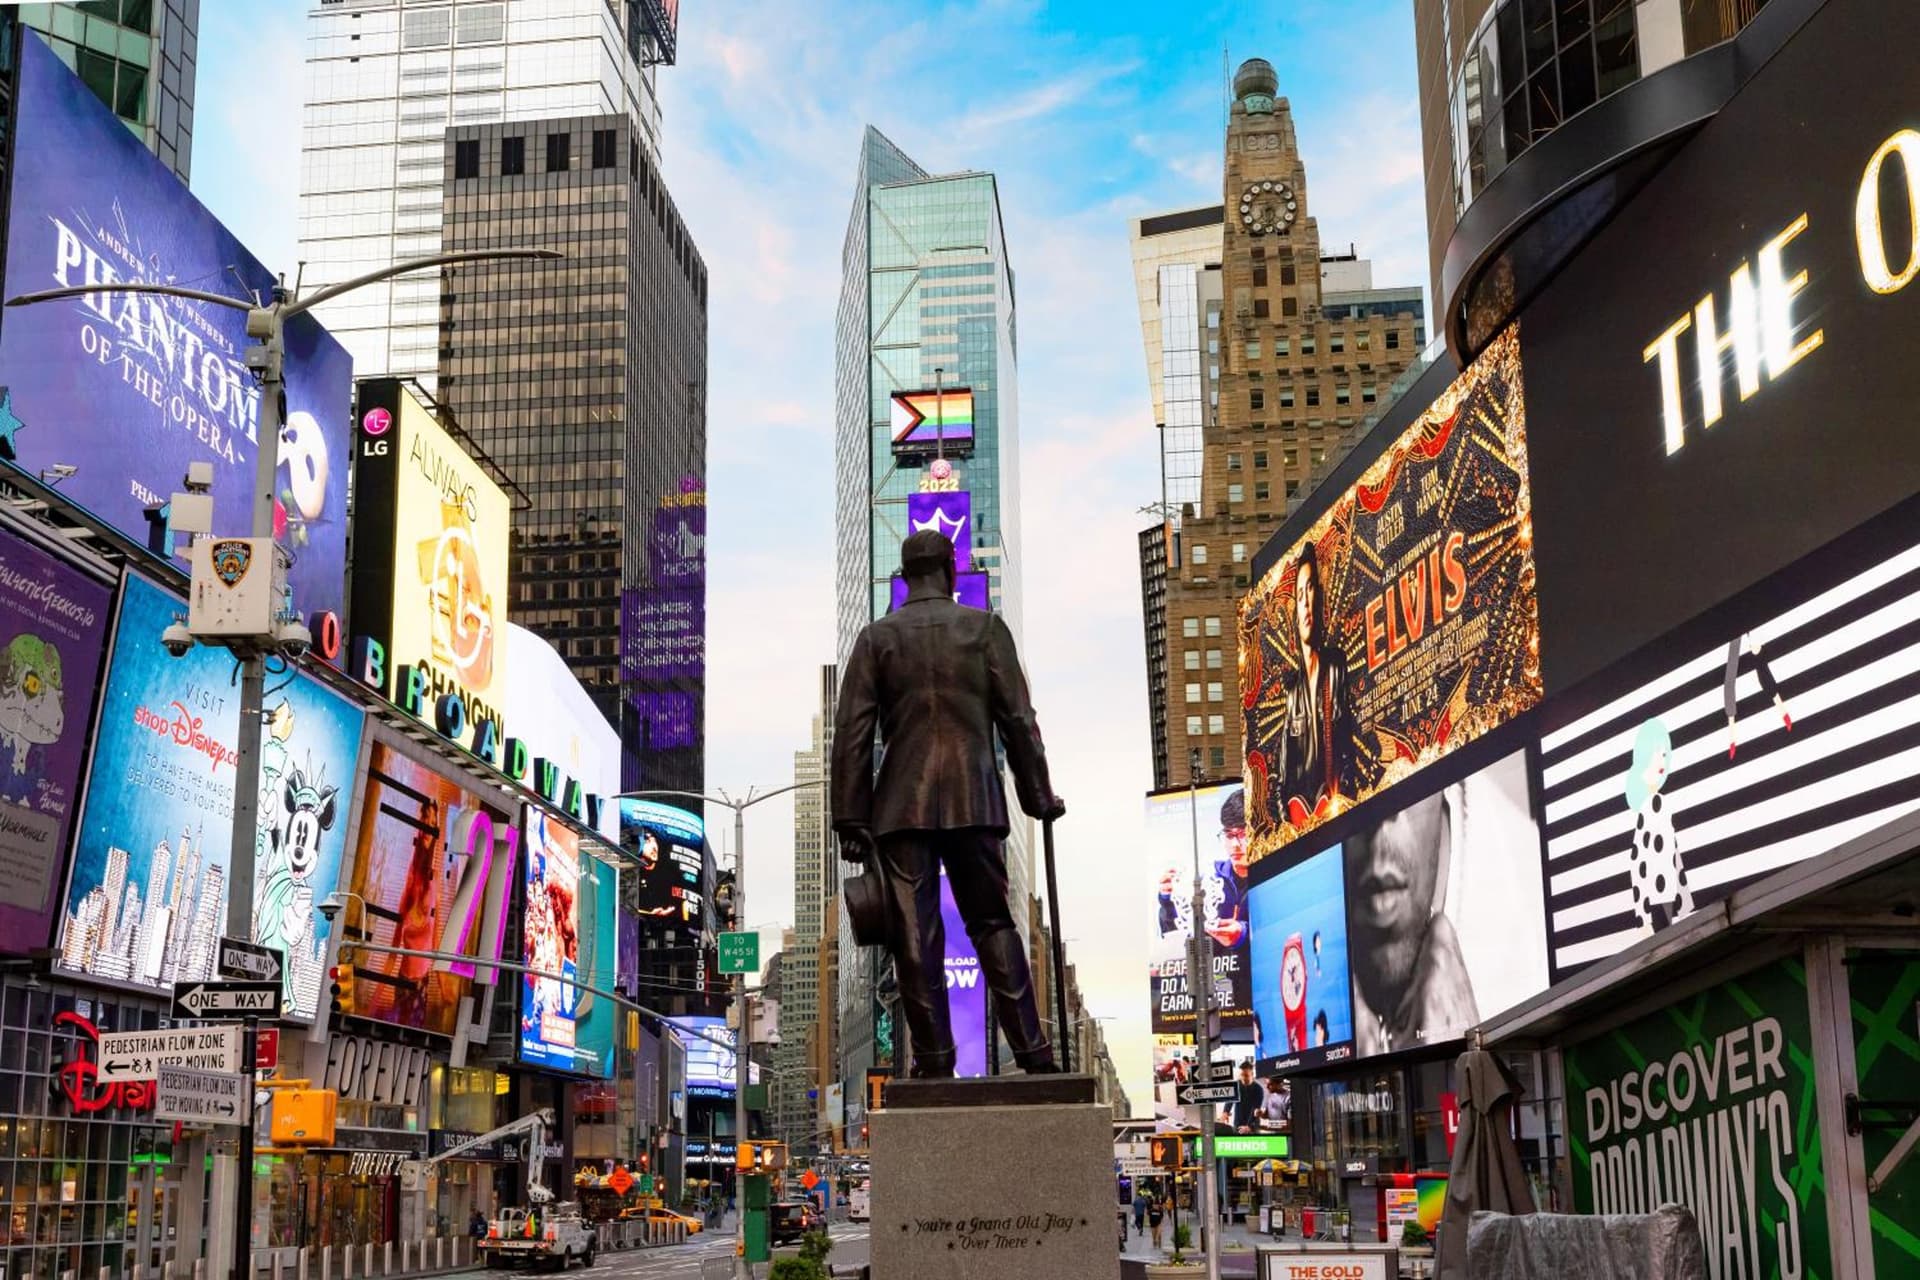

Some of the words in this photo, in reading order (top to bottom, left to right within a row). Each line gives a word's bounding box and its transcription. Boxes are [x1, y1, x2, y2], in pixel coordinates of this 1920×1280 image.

[98, 227, 146, 273] ANDREW
[49, 216, 259, 447] PHANTOM
[186, 305, 234, 354] WEBBER'S
[1643, 212, 1824, 457] THE
[81, 324, 112, 364] OF
[121, 352, 163, 407] THE
[364, 440, 388, 457] LG
[410, 432, 478, 523] ALWAYS
[919, 478, 960, 492] 2022
[1377, 501, 1403, 535] AUSTIN
[1376, 515, 1405, 553] BUTLER
[1366, 531, 1467, 673] ELVIS
[186, 682, 225, 716] VISIT
[416, 659, 504, 747] CHANGIN
[1401, 694, 1424, 723] JUNE
[1426, 683, 1438, 707] 24
[355, 635, 605, 833] BROADWAY
[127, 766, 177, 796] DELIVERED
[180, 786, 191, 802] TO
[193, 795, 215, 814] YOUR
[145, 753, 158, 769] TO
[161, 760, 184, 781] HAVE
[187, 770, 203, 788] THE
[205, 779, 233, 801] MAGIC
[434, 809, 519, 986] 21
[724, 948, 731, 957] W
[732, 948, 744, 957] 45
[734, 936, 744, 945] TO
[229, 951, 249, 969] ONE
[255, 956, 275, 974] WAY
[696, 949, 705, 991] 1500
[1213, 954, 1240, 974] ORE.
[189, 993, 219, 1008] ONE
[235, 992, 268, 1008] WAY
[1161, 978, 1178, 995] DO
[1161, 995, 1194, 1013] EARN
[104, 1037, 165, 1055] PEDESTRIAN
[168, 1035, 196, 1051] FLOW
[199, 1033, 225, 1049] ZONE
[186, 1054, 225, 1070] MOVING
[323, 1033, 432, 1107] FOREVER
[161, 1072, 201, 1092] PEDESTRIAN
[202, 1078, 219, 1095] FLOW
[220, 1079, 236, 1096] ZONE
[1186, 1089, 1204, 1099] ONE
[1211, 1087, 1232, 1097] WAY
[1585, 1017, 1787, 1143] DISCOVER
[161, 1095, 175, 1112] KEEP
[178, 1096, 203, 1113] MOVING
[1218, 1141, 1268, 1151] FRIENDS
[349, 1152, 395, 1176] FOREVER
[914, 1218, 953, 1234] You're
[956, 1219, 967, 1232] a
[970, 1216, 1012, 1234] Grand
[1016, 1215, 1040, 1230] Old
[1043, 1213, 1074, 1233] Flag
[959, 1234, 990, 1250] Over
[993, 1233, 1028, 1249] There
[1288, 1266, 1317, 1278] THE
[1321, 1266, 1364, 1278] GOLD
